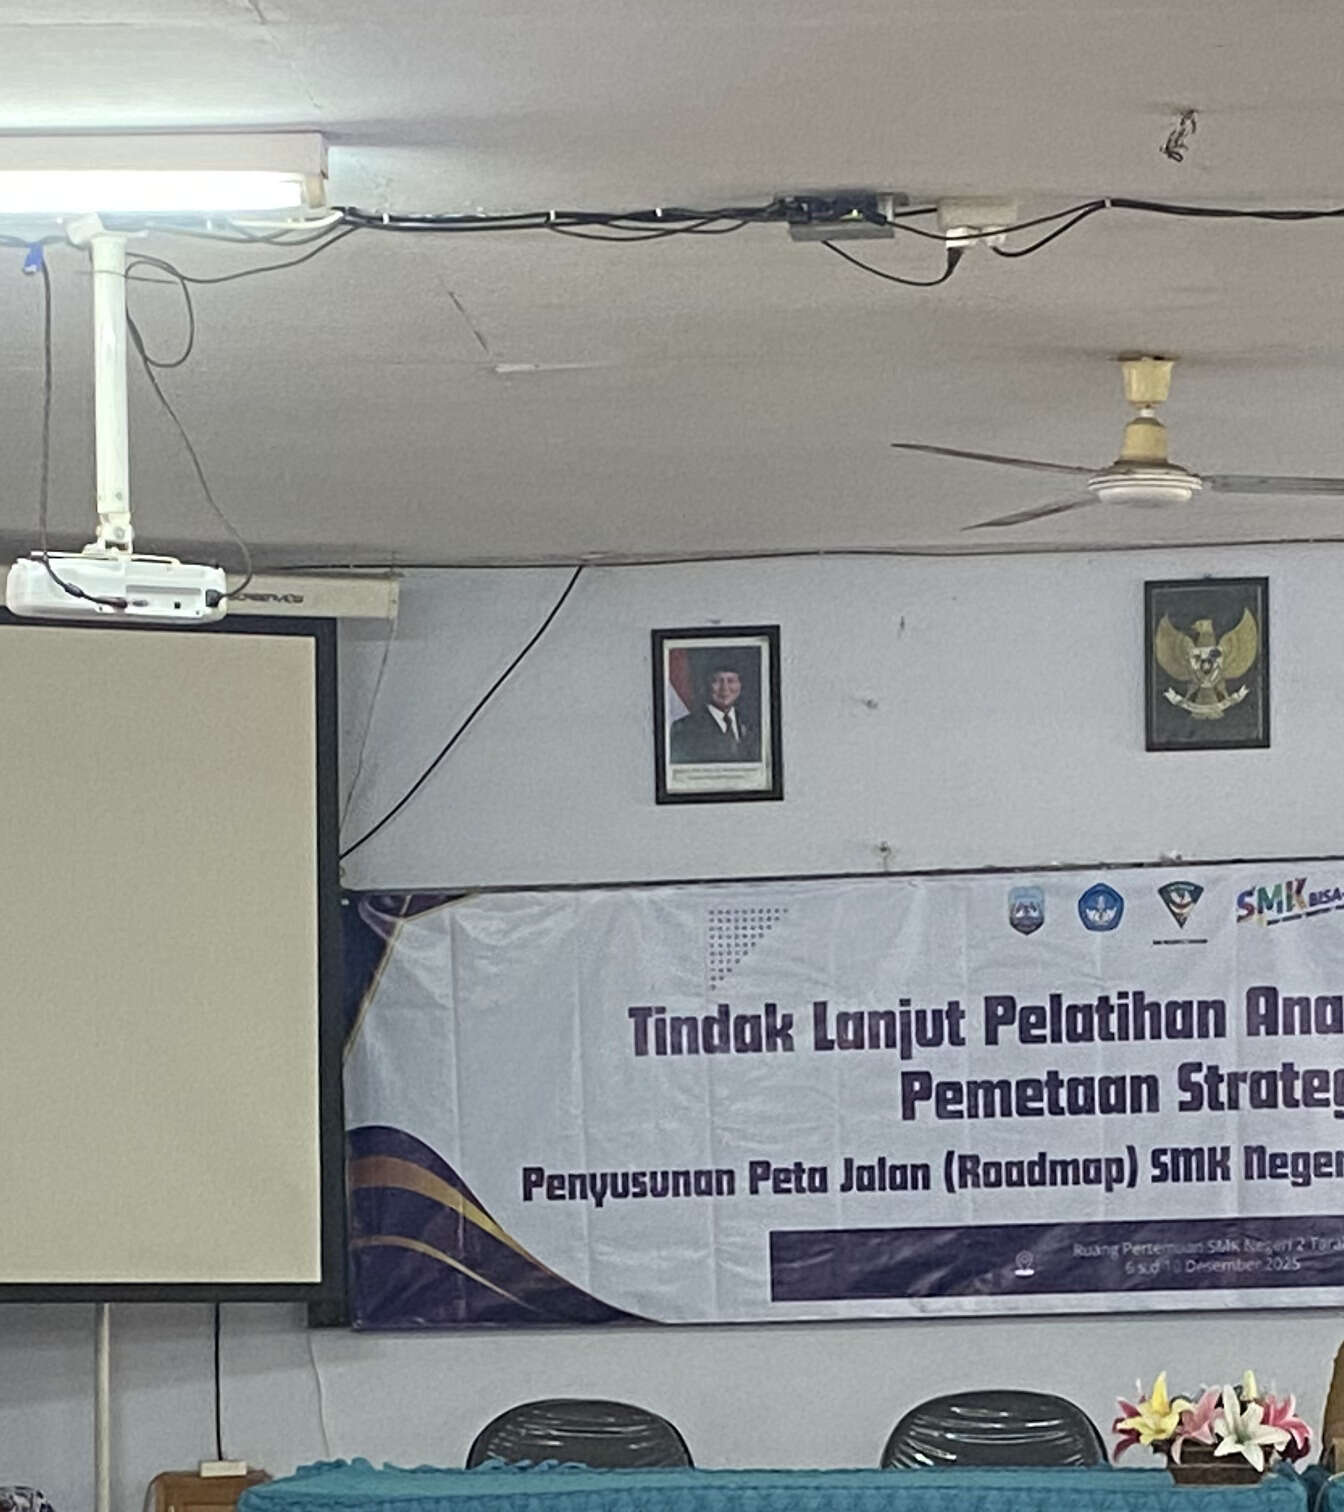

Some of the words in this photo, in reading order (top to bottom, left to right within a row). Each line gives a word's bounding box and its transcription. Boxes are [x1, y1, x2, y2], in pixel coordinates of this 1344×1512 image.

[1236, 877, 1307, 923] SMK
[628, 1003, 794, 1056] Tindak
[813, 998, 966, 1060] Lanjut
[984, 991, 1226, 1045] Pelatihan
[901, 1070, 1159, 1120] Pemetaan
[523, 1167, 735, 1208] Penyusunan
[749, 1160, 828, 1195] Peta
[840, 1157, 930, 1192] Jalan
[944, 1145, 1138, 1193] (Roadmap)
[1151, 1146, 1230, 1183] SMK
[1266, 1256, 1302, 1271] 2025
